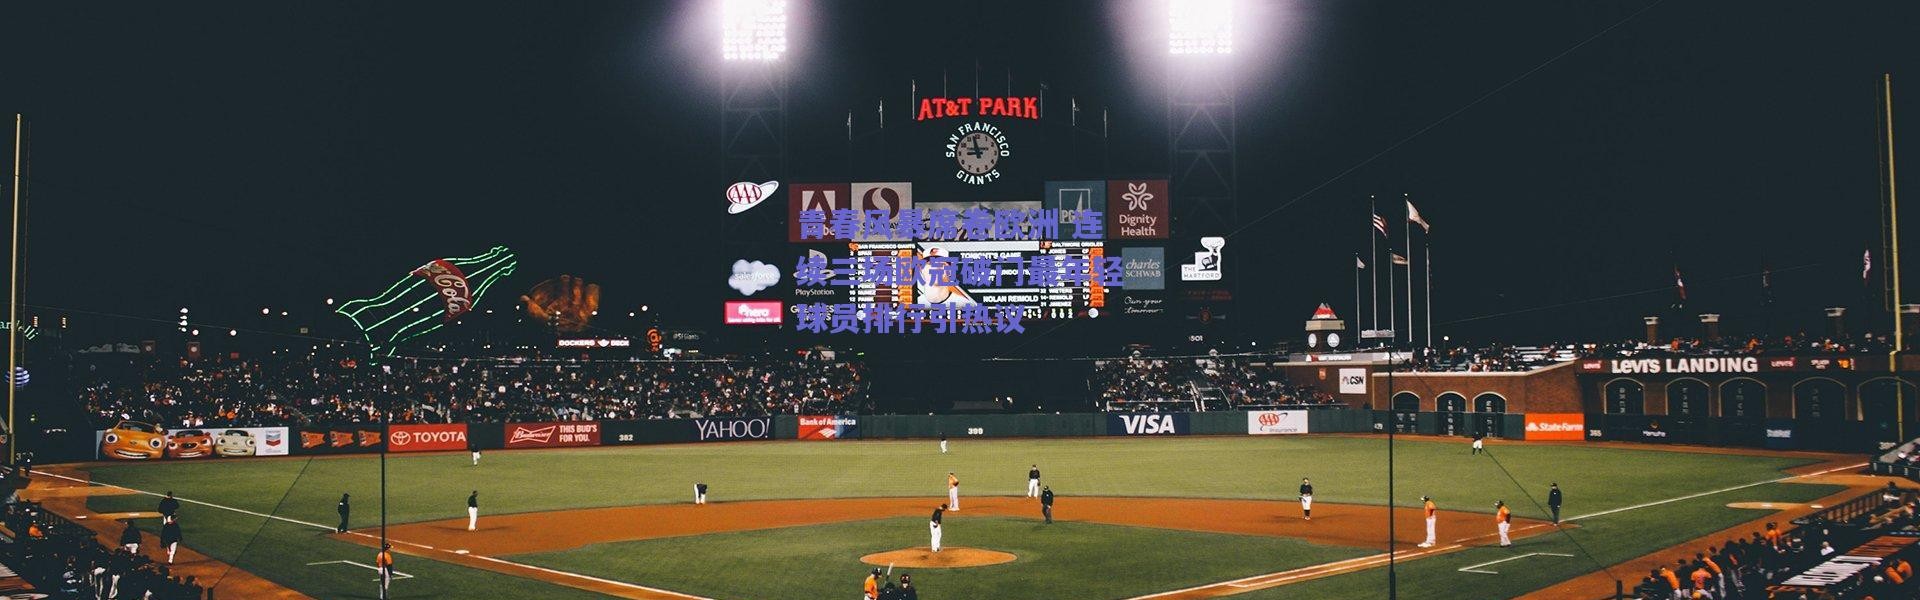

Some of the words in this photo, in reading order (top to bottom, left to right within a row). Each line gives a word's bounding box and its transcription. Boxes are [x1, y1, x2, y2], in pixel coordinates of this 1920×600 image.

[917, 98, 972, 121] AT&T
[979, 96, 1039, 120] PARK
[945, 133, 960, 158] SAN
[958, 121, 1010, 157] FRANCISCO
[956, 168, 1001, 185] GIANTS
[729, 184, 761, 204] AAA
[1118, 214, 1157, 227] Dignity
[1121, 226, 1156, 237] Health
[1125, 258, 1160, 269] charles
[734, 271, 775, 282] salesforce
[1125, 270, 1161, 278] SCHWAB
[795, 288, 835, 297] PlayStation
[982, 295, 1007, 303] NOLAN
[1008, 295, 1039, 303] REIMOLD
[558, 339, 596, 347] DOCKERS
[610, 339, 630, 347] DECK
[1665, 357, 1758, 373] LANDING
[1349, 376, 1364, 385] CSN
[800, 418, 818, 426] Bank
[826, 418, 856, 426] America
[1119, 414, 1176, 435] VISA
[1259, 413, 1280, 426] AAA
[559, 425, 576, 433] THIS
[576, 424, 598, 433] BUD'S
[696, 417, 770, 440] YAHOO!
[412, 431, 467, 443] TOYOTA
[514, 430, 552, 440] Budweiser
[559, 434, 573, 443] FOR
[574, 433, 590, 442] YOU.
